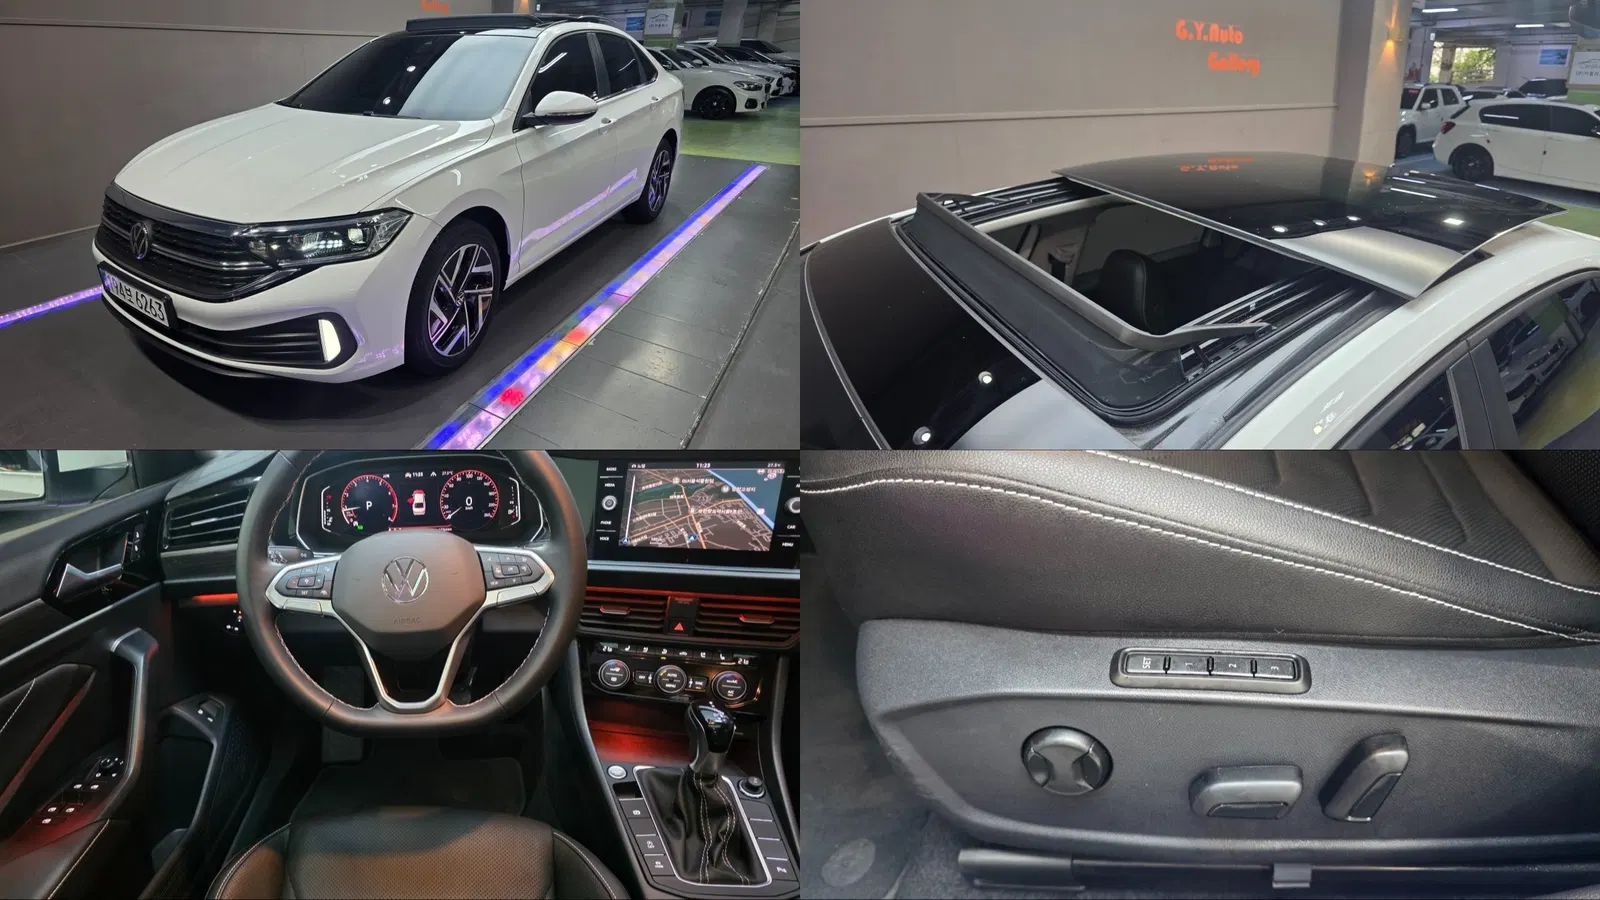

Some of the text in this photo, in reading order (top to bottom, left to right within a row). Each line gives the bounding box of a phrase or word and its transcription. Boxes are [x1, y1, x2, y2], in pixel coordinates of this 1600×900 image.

[1175, 18, 1244, 44] G.Y.Auto
[1207, 52, 1260, 77] Gallery
[136, 290, 165, 320] 6263
[366, 501, 372, 510] P
[465, 496, 473, 506] 0
[1142, 657, 1151, 669] SET
